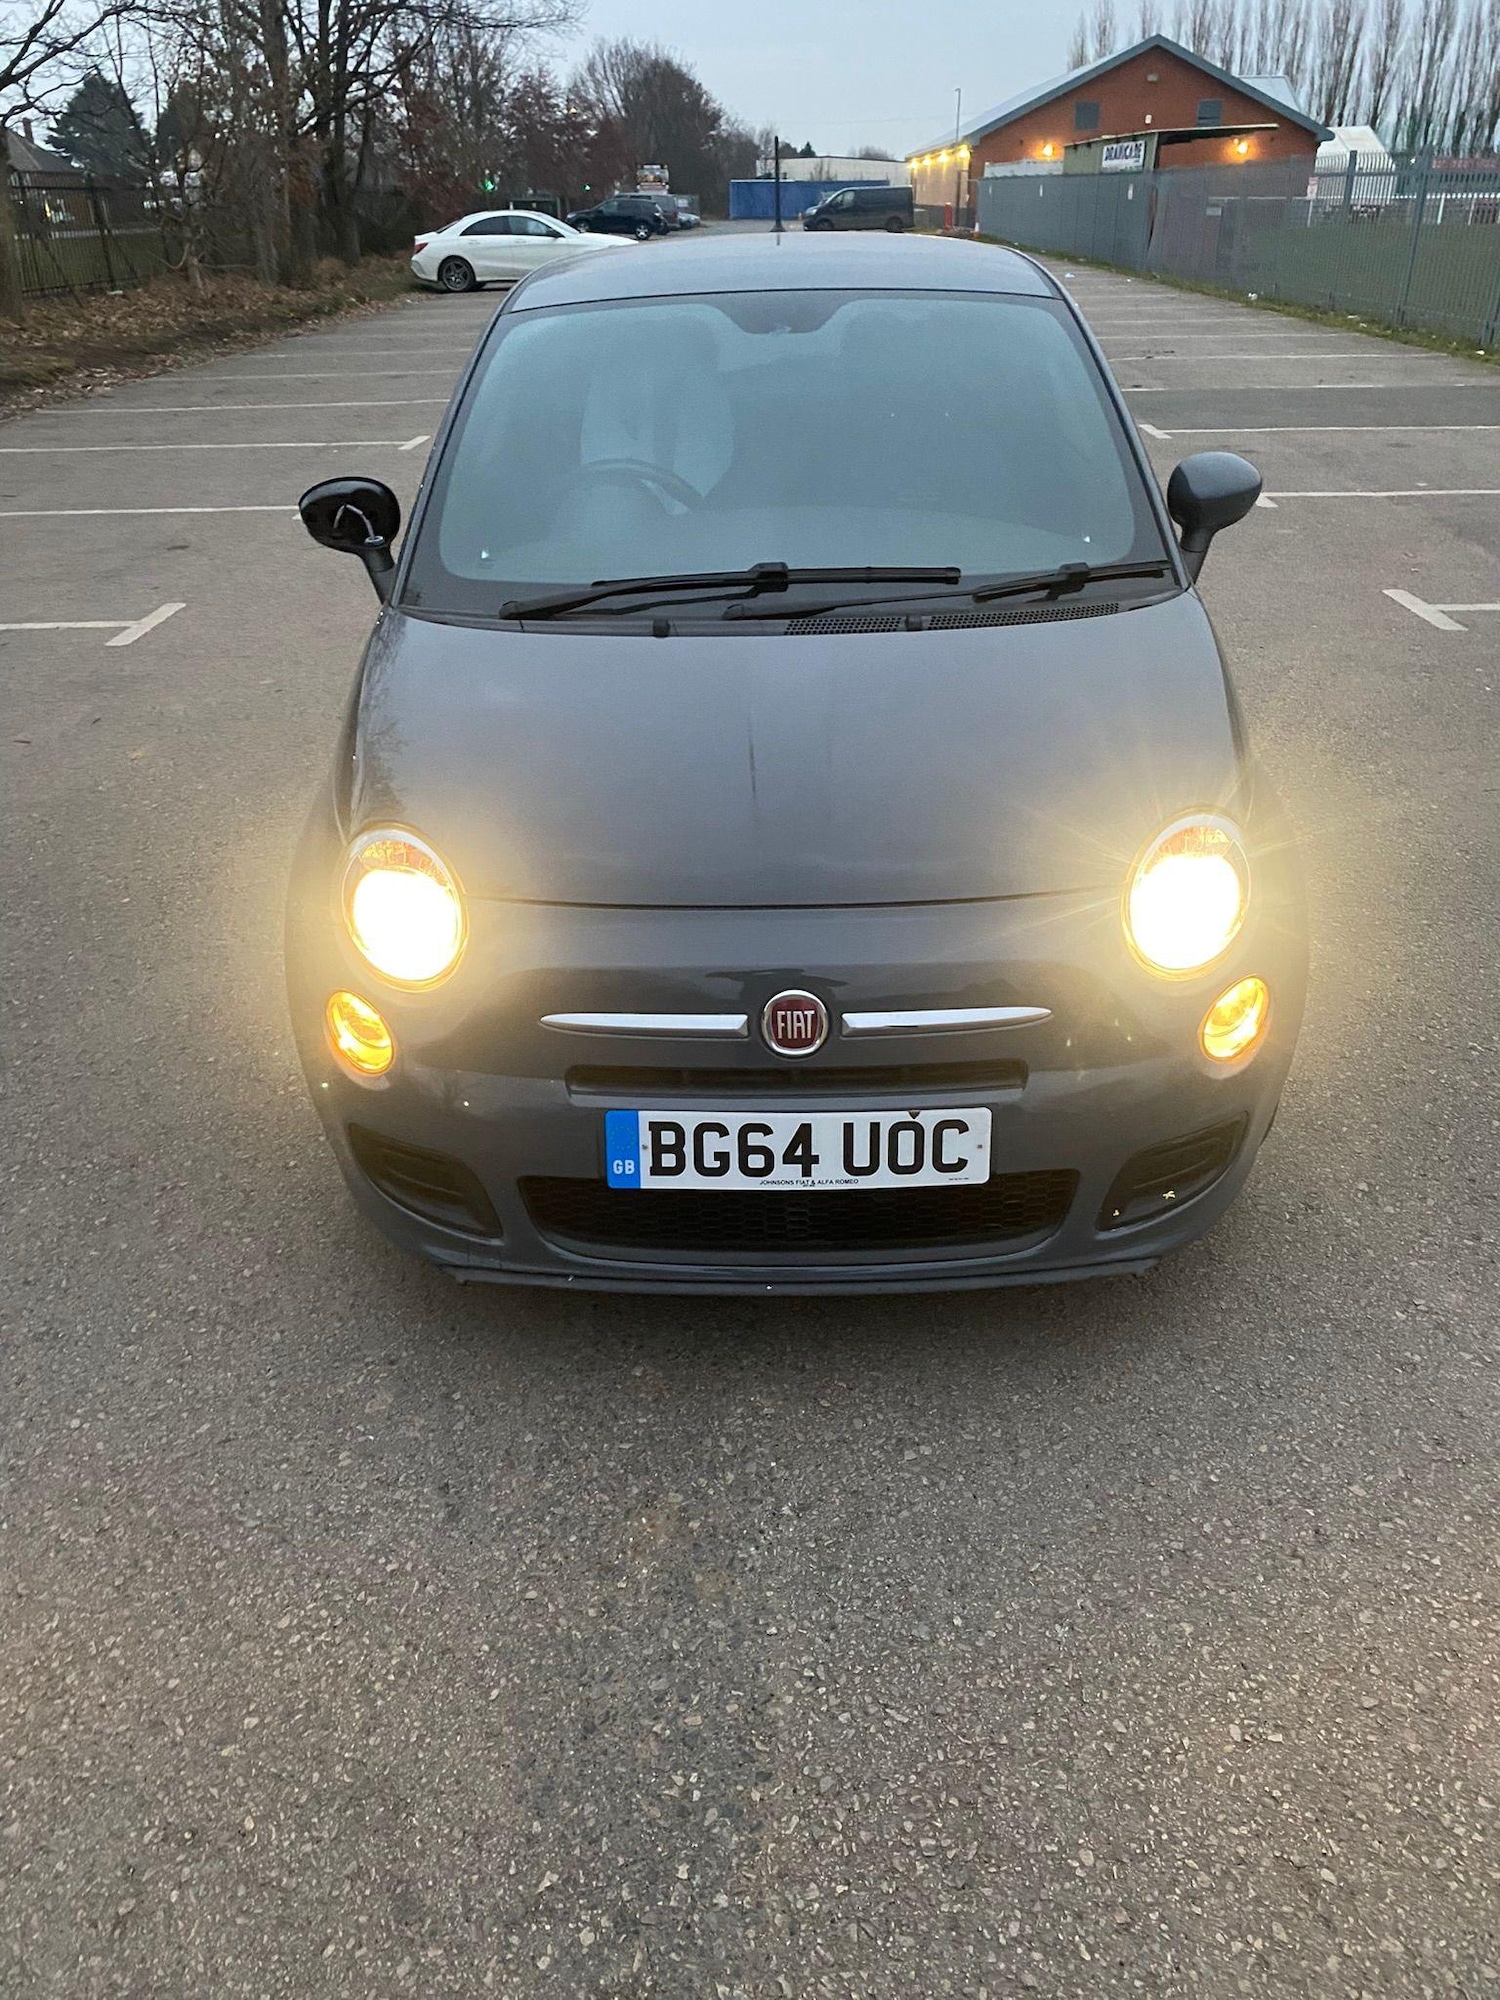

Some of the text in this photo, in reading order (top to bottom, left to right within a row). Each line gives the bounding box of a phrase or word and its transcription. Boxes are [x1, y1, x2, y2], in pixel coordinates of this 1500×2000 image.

[777, 1010, 815, 1039] FIAT
[649, 1118, 970, 1178] BG64 UOC
[613, 1159, 635, 1175] GB
